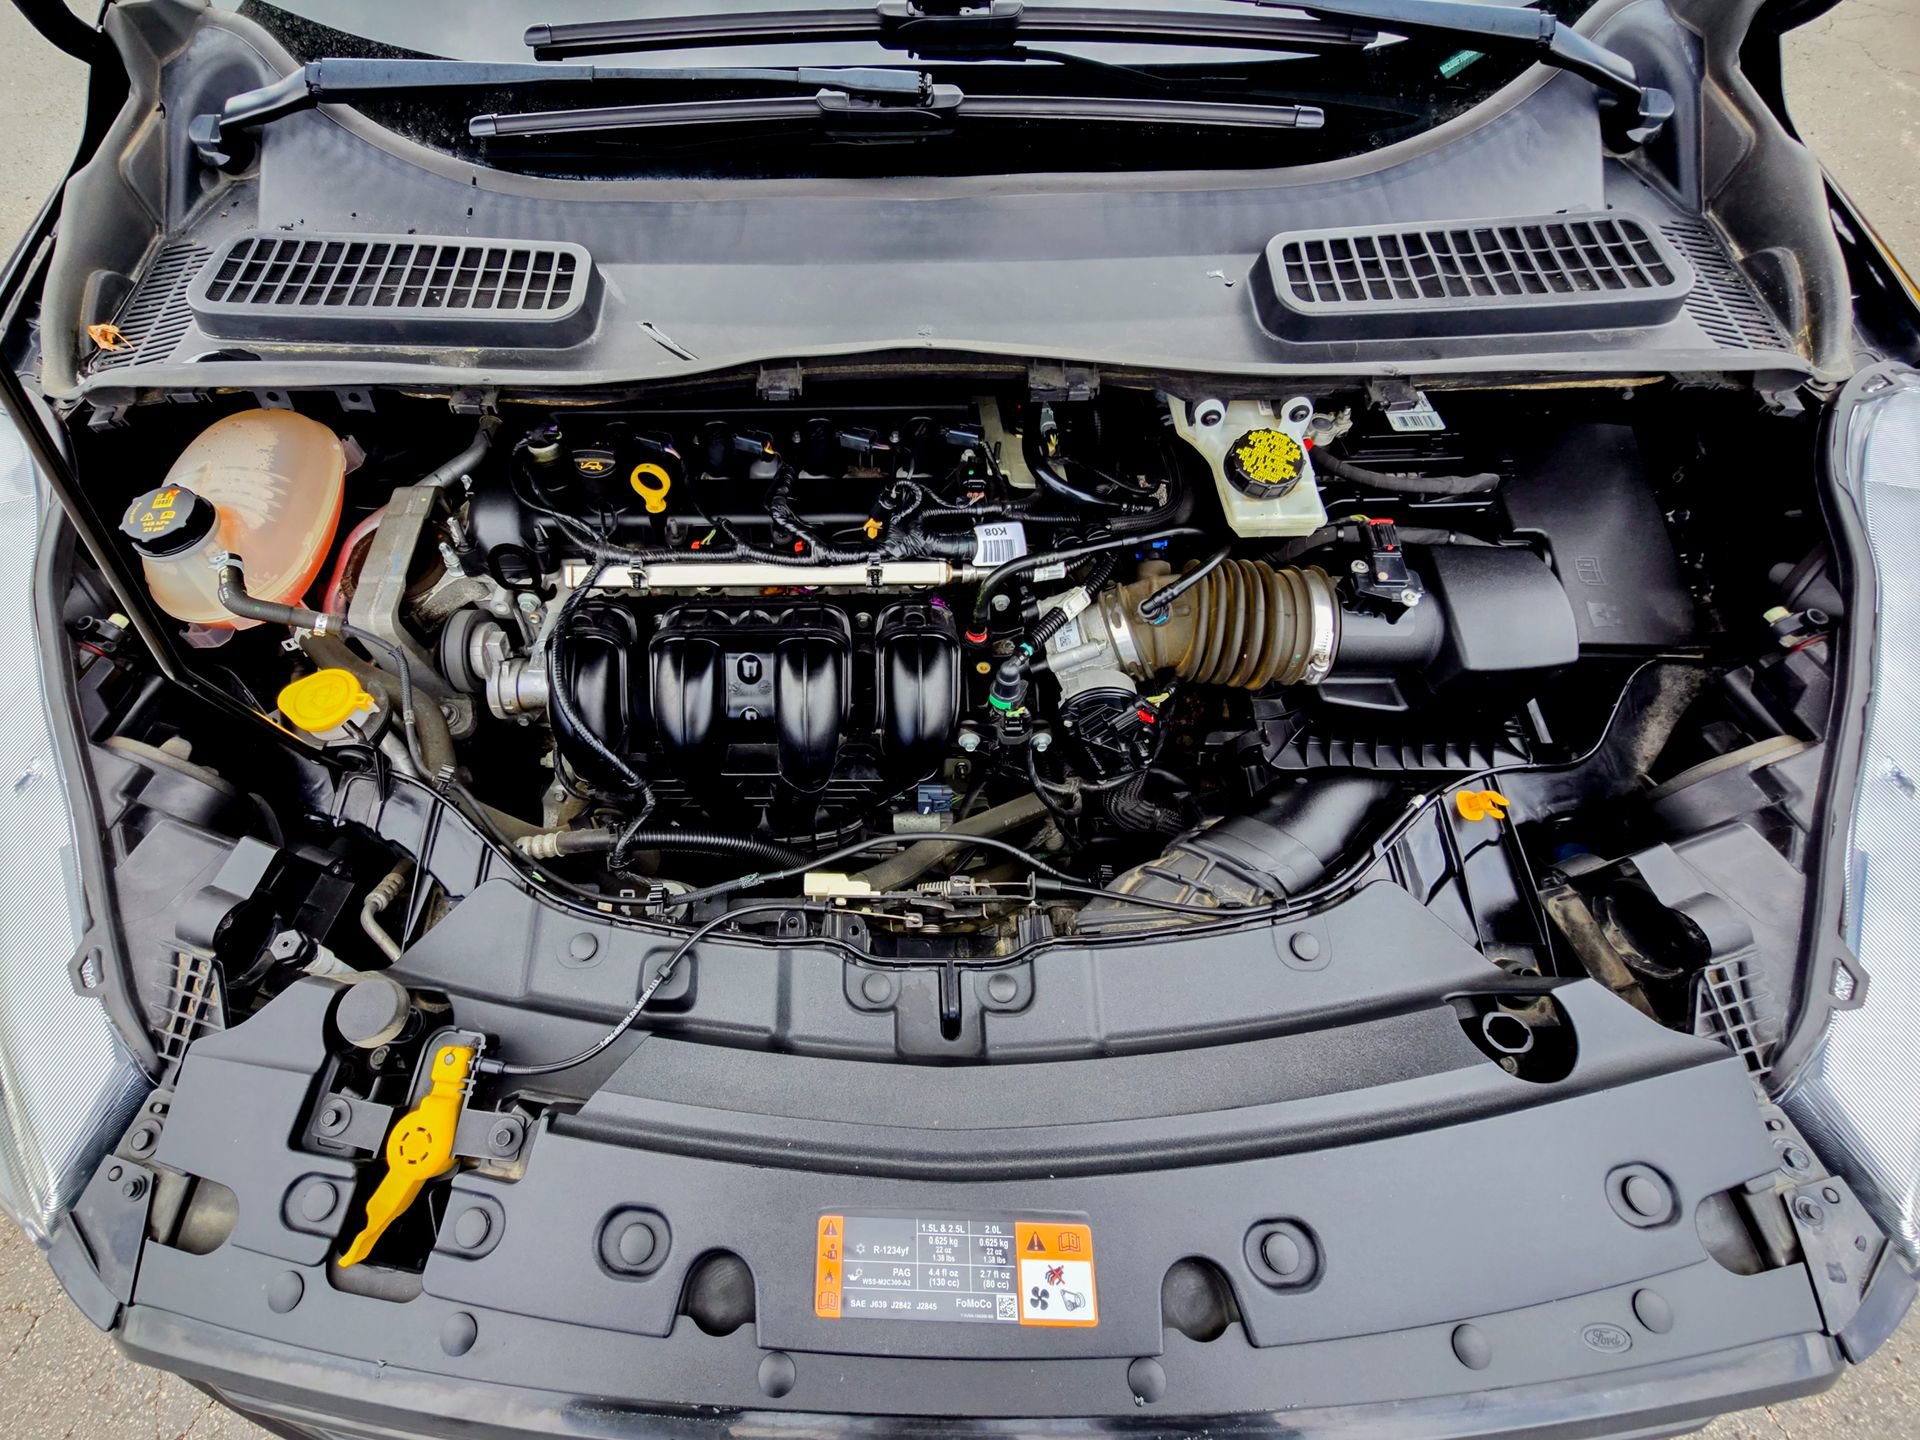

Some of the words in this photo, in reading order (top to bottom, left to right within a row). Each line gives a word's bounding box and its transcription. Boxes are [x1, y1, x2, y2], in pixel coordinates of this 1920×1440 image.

[984, 527, 1007, 536] K08
[922, 1223, 938, 1232] 1.5L
[940, 1224, 946, 1232] &
[948, 1225, 965, 1233] 2.5L
[985, 1225, 1001, 1234] 2.0L
[928, 1236, 947, 1245] 0.625
[949, 1237, 958, 1247] kg
[979, 1238, 998, 1247] 0.625
[999, 1239, 1008, 1249] kg
[873, 1245, 909, 1256] R-1234yf
[997, 1256, 1006, 1264] lbs
[892, 1268, 911, 1277] PAG
[928, 1268, 940, 1276] 4.4
[941, 1268, 947, 1276] fl
[948, 1269, 958, 1277] oz
[980, 1270, 991, 1278] 2.7
[993, 1270, 999, 1278] fl
[1000, 1271, 1010, 1279] oz
[929, 1277, 946, 1288] (130
[947, 1278, 960, 1289] cc)
[983, 1279, 995, 1289] (80
[997, 1280, 1009, 1290] cc)
[850, 1299, 866, 1307] SAE
[870, 1300, 887, 1308] J639
[916, 1302, 938, 1310] J2845
[955, 1298, 992, 1308] FoMoCo
[1592, 1328, 1621, 1346] Ford
